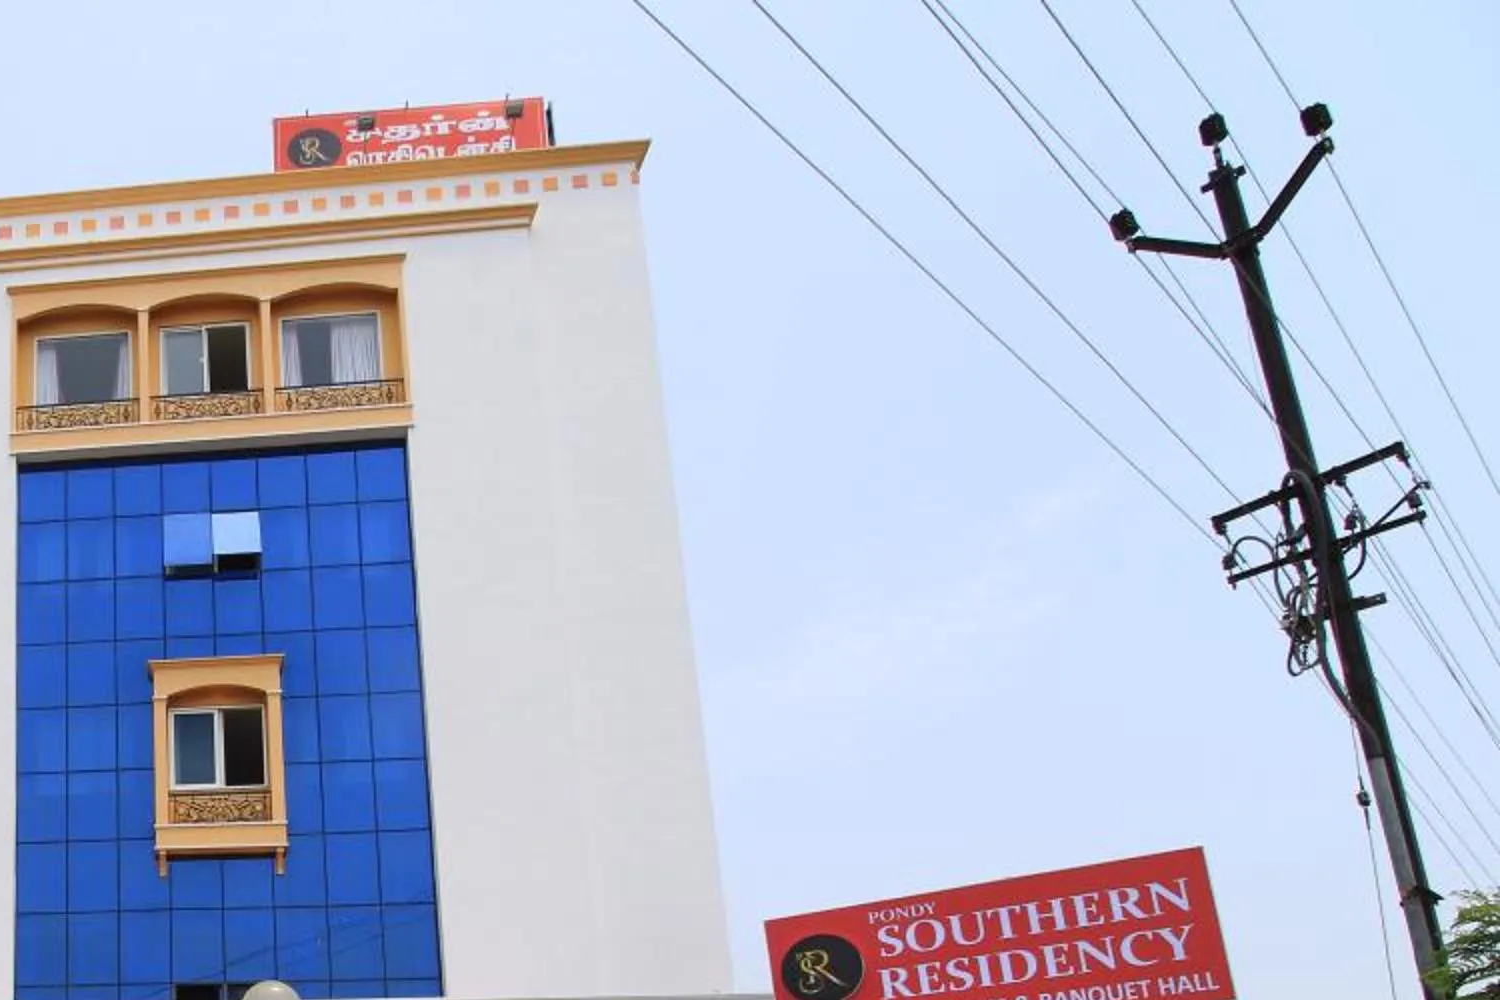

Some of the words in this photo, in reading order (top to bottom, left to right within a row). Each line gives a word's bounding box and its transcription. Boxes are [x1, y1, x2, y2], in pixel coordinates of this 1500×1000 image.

[868, 902, 936, 925] PONDY
[877, 877, 1192, 959] SOUTHERN
[1157, 971, 1220, 995] HALL
